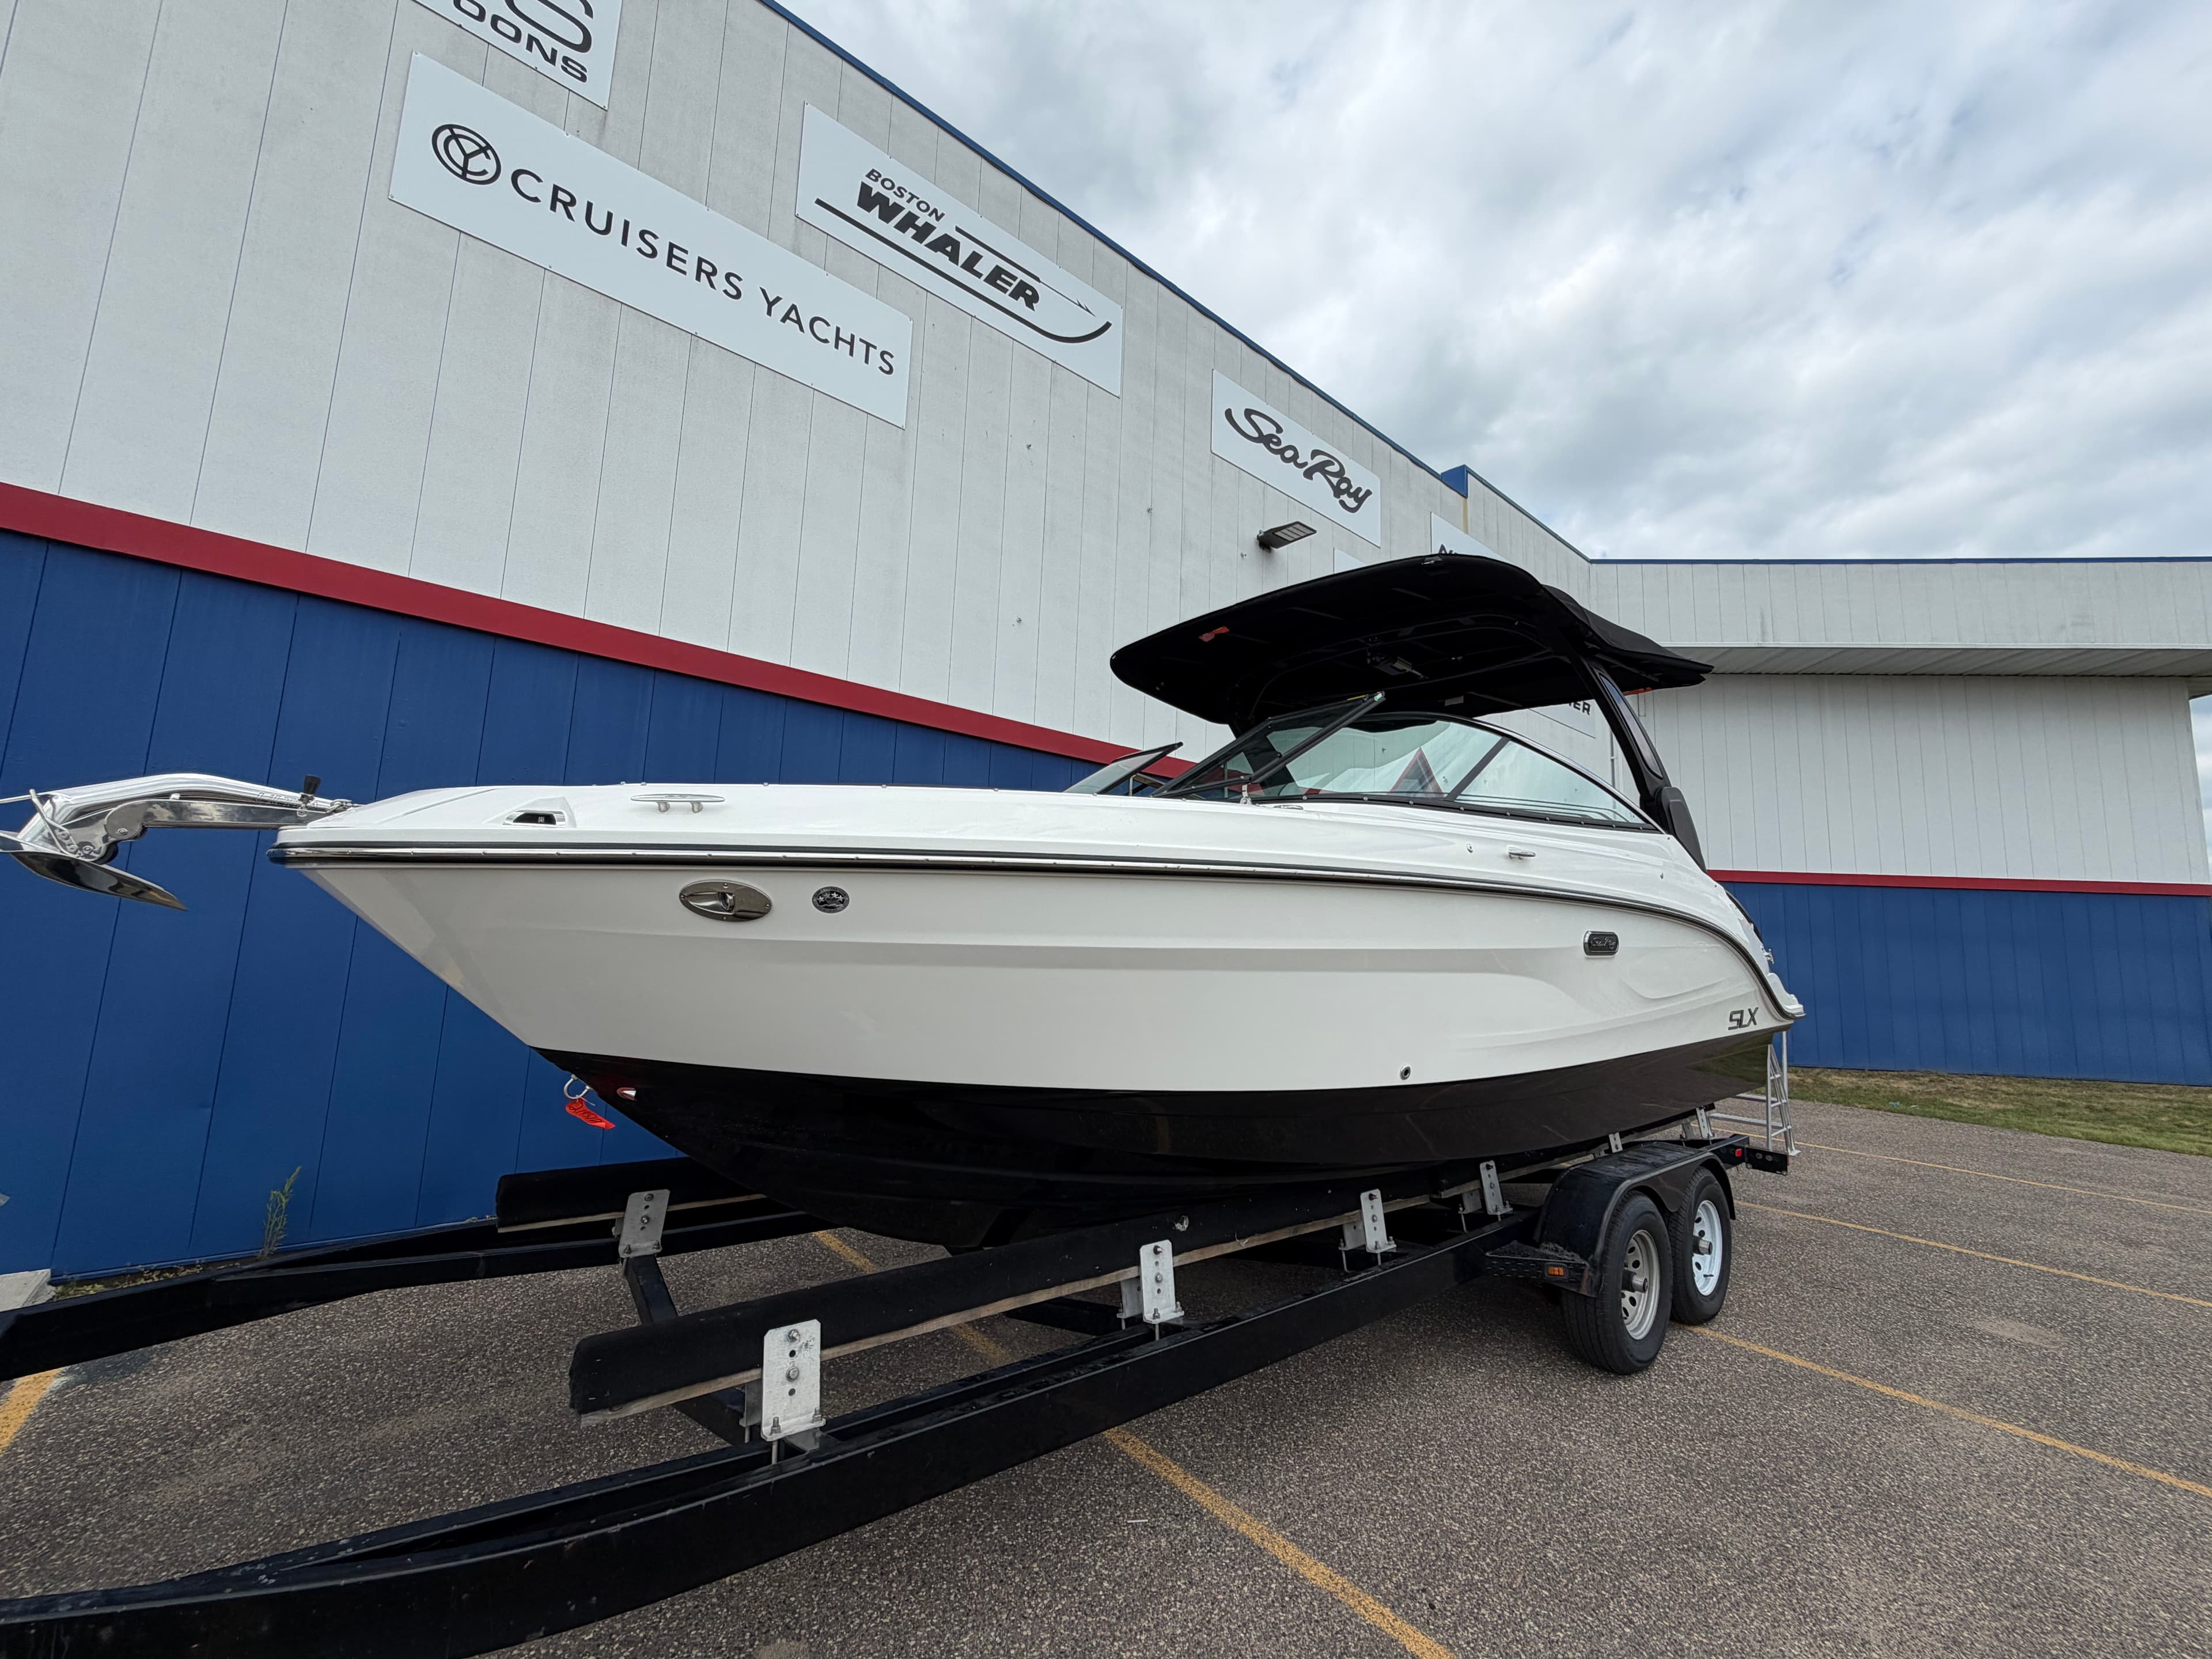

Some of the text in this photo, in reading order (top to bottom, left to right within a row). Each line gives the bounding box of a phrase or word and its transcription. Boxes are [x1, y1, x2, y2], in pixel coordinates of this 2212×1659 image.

[857, 181, 1040, 311] WHALER
[865, 168, 945, 222] BOSTON
[511, 169, 894, 375] CRUISERS YACHTS
[1225, 408, 1373, 513] Sea Ray
[1728, 1007, 1759, 1030] SLX
